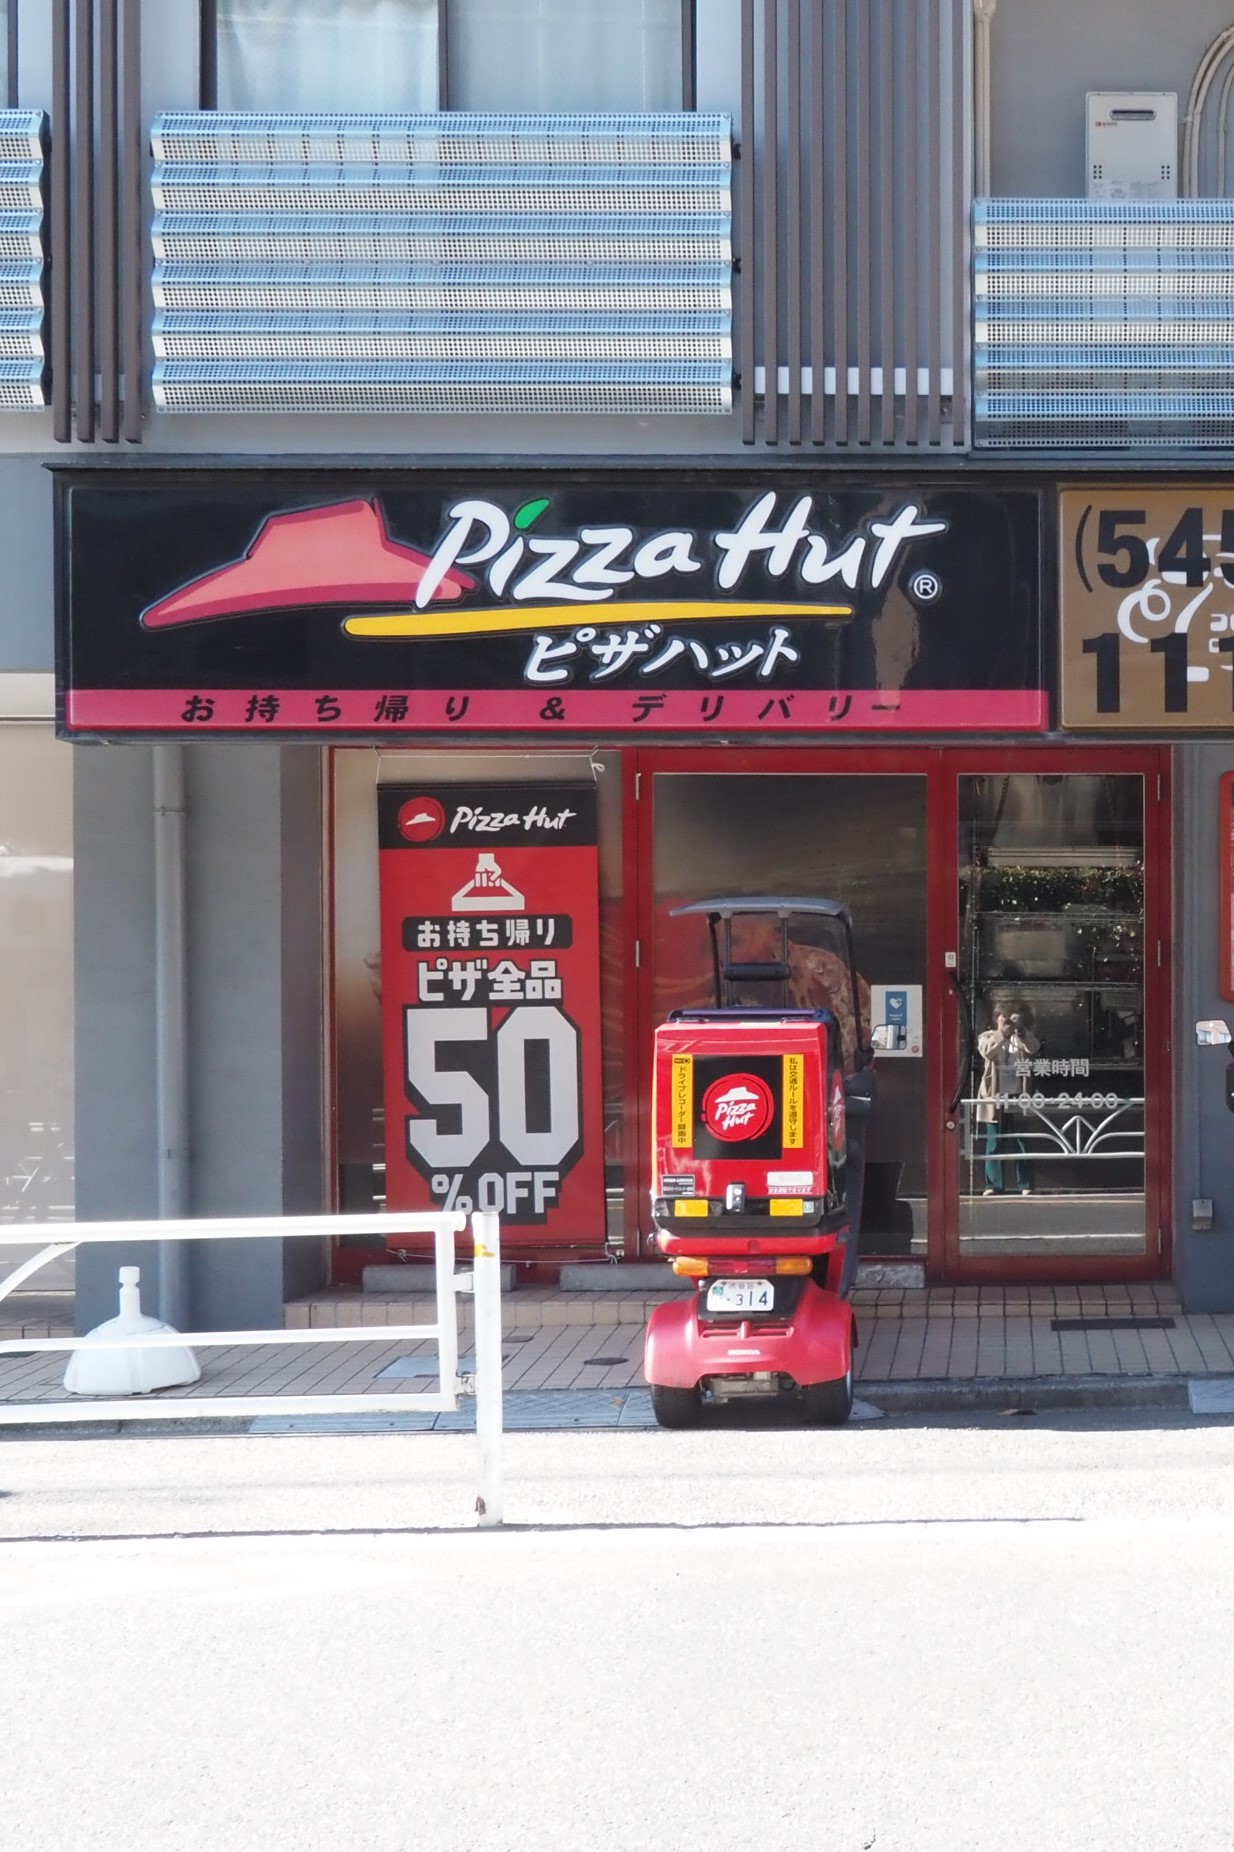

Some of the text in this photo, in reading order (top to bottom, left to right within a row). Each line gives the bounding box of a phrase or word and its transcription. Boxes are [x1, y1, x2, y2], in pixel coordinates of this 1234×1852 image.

[415, 497, 701, 608] Pizza
[714, 491, 948, 590] Hut
[525, 624, 799, 682] ピザハット
[181, 694, 902, 723] お持ち帰り & デリバリー
[450, 805, 577, 834] Pizza Hut
[417, 919, 556, 948] お持ち帰り
[418, 958, 563, 1001] ピザ全品
[1014, 1058, 1090, 1077] 営業時間
[407, 1006, 579, 1167] 50
[715, 1101, 756, 1121] Pizza
[722, 1113, 754, 1131] Hut
[432, 1171, 560, 1214] %OFF
